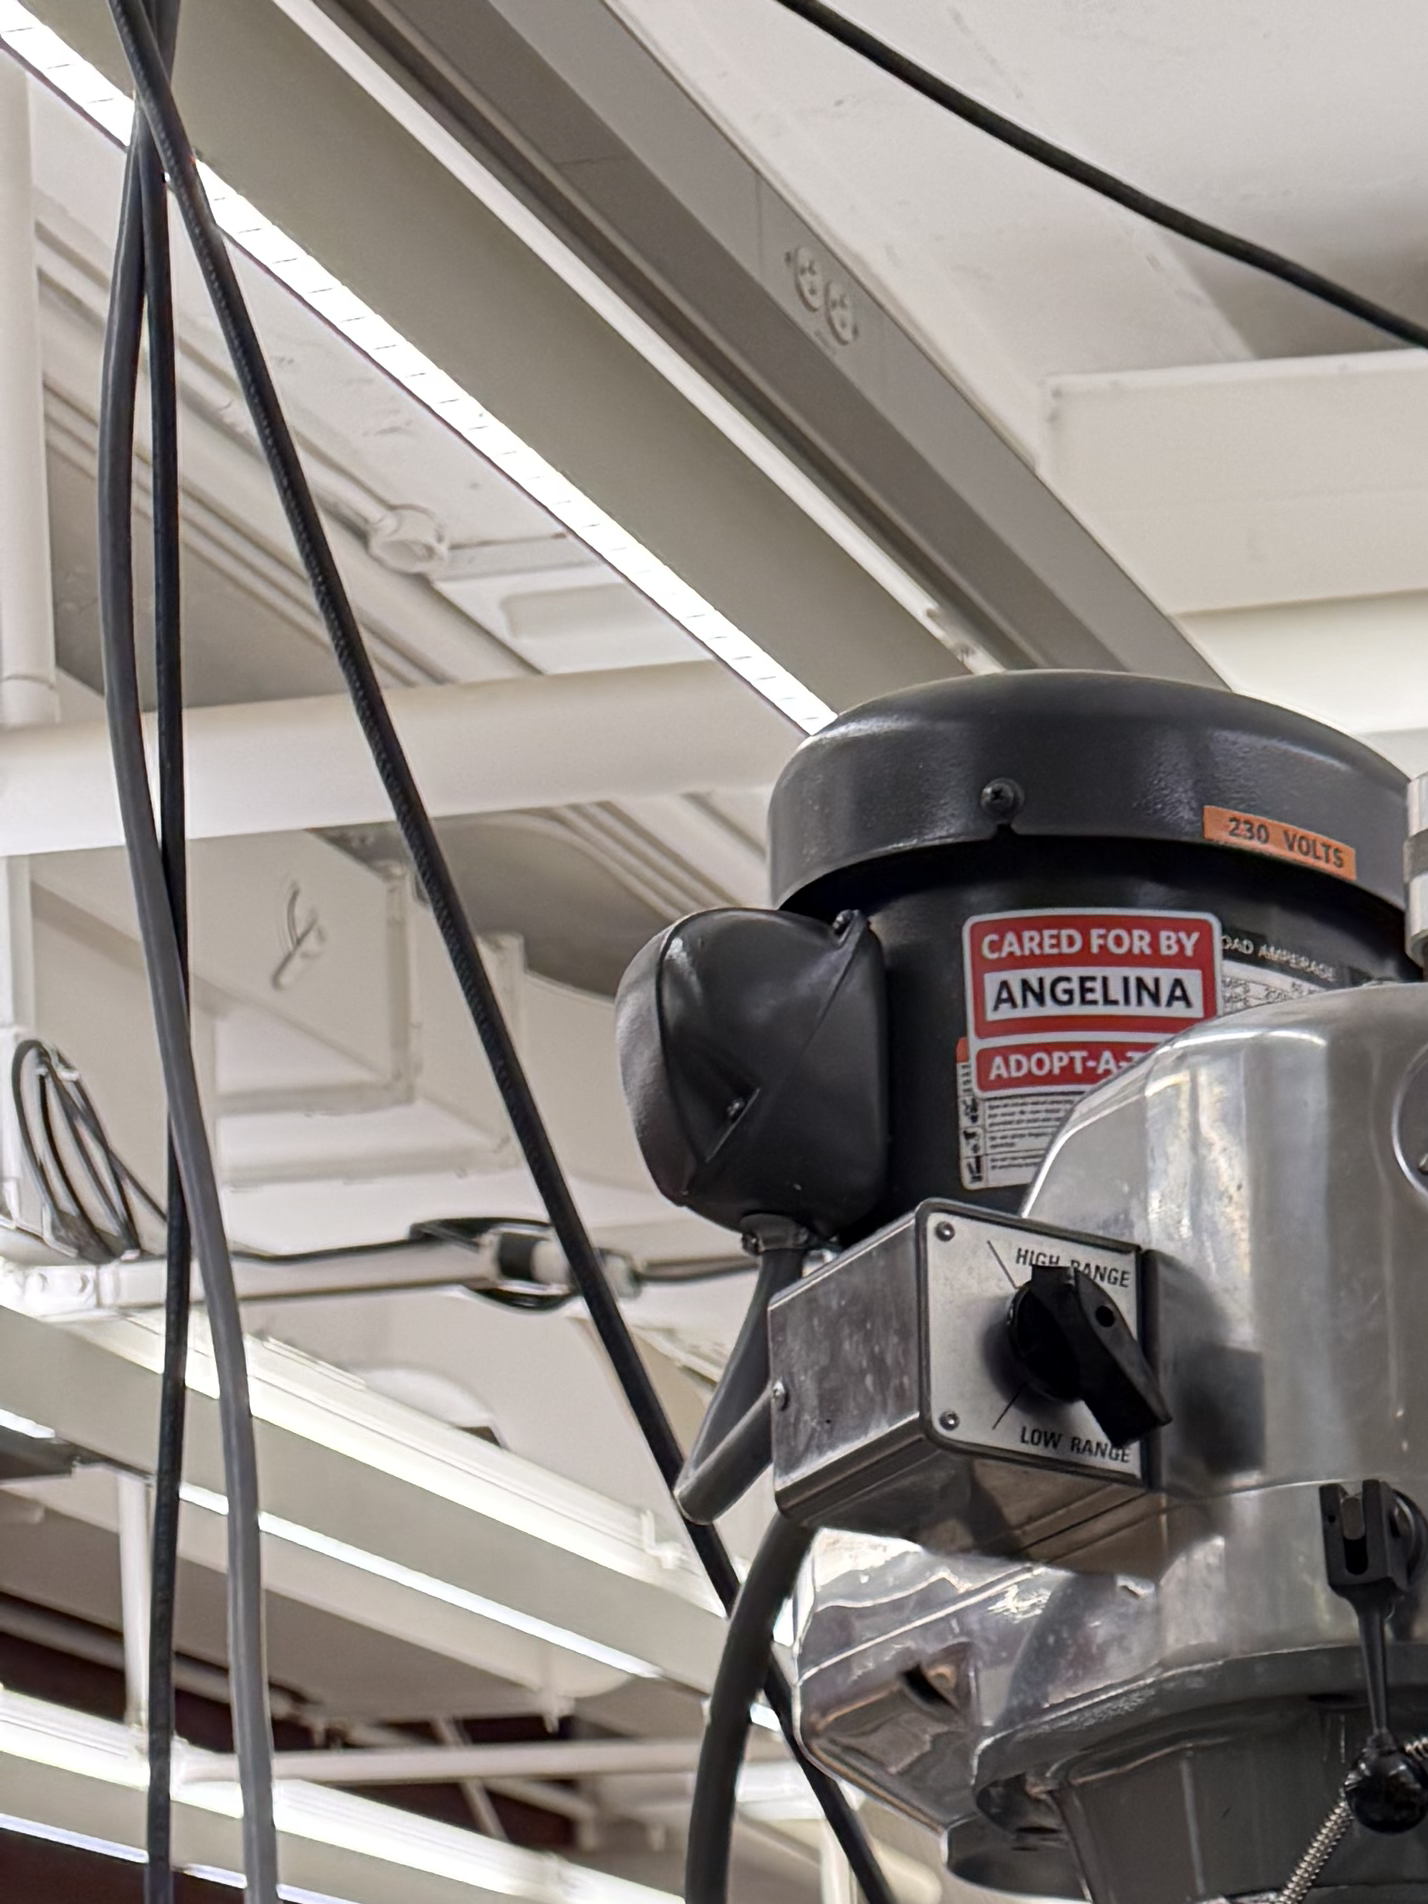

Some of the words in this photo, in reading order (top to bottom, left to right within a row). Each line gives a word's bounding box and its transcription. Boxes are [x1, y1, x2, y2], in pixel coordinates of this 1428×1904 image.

[1228, 816, 1270, 845] 230
[1283, 829, 1344, 869] VOLTS
[981, 928, 1083, 961] CARED
[1090, 927, 1152, 957] FOR
[1159, 931, 1200, 958] BY
[992, 974, 1194, 1012] ANGELINA
[1020, 1426, 1064, 1450] LOW
[1070, 1436, 1132, 1464] RANGE
